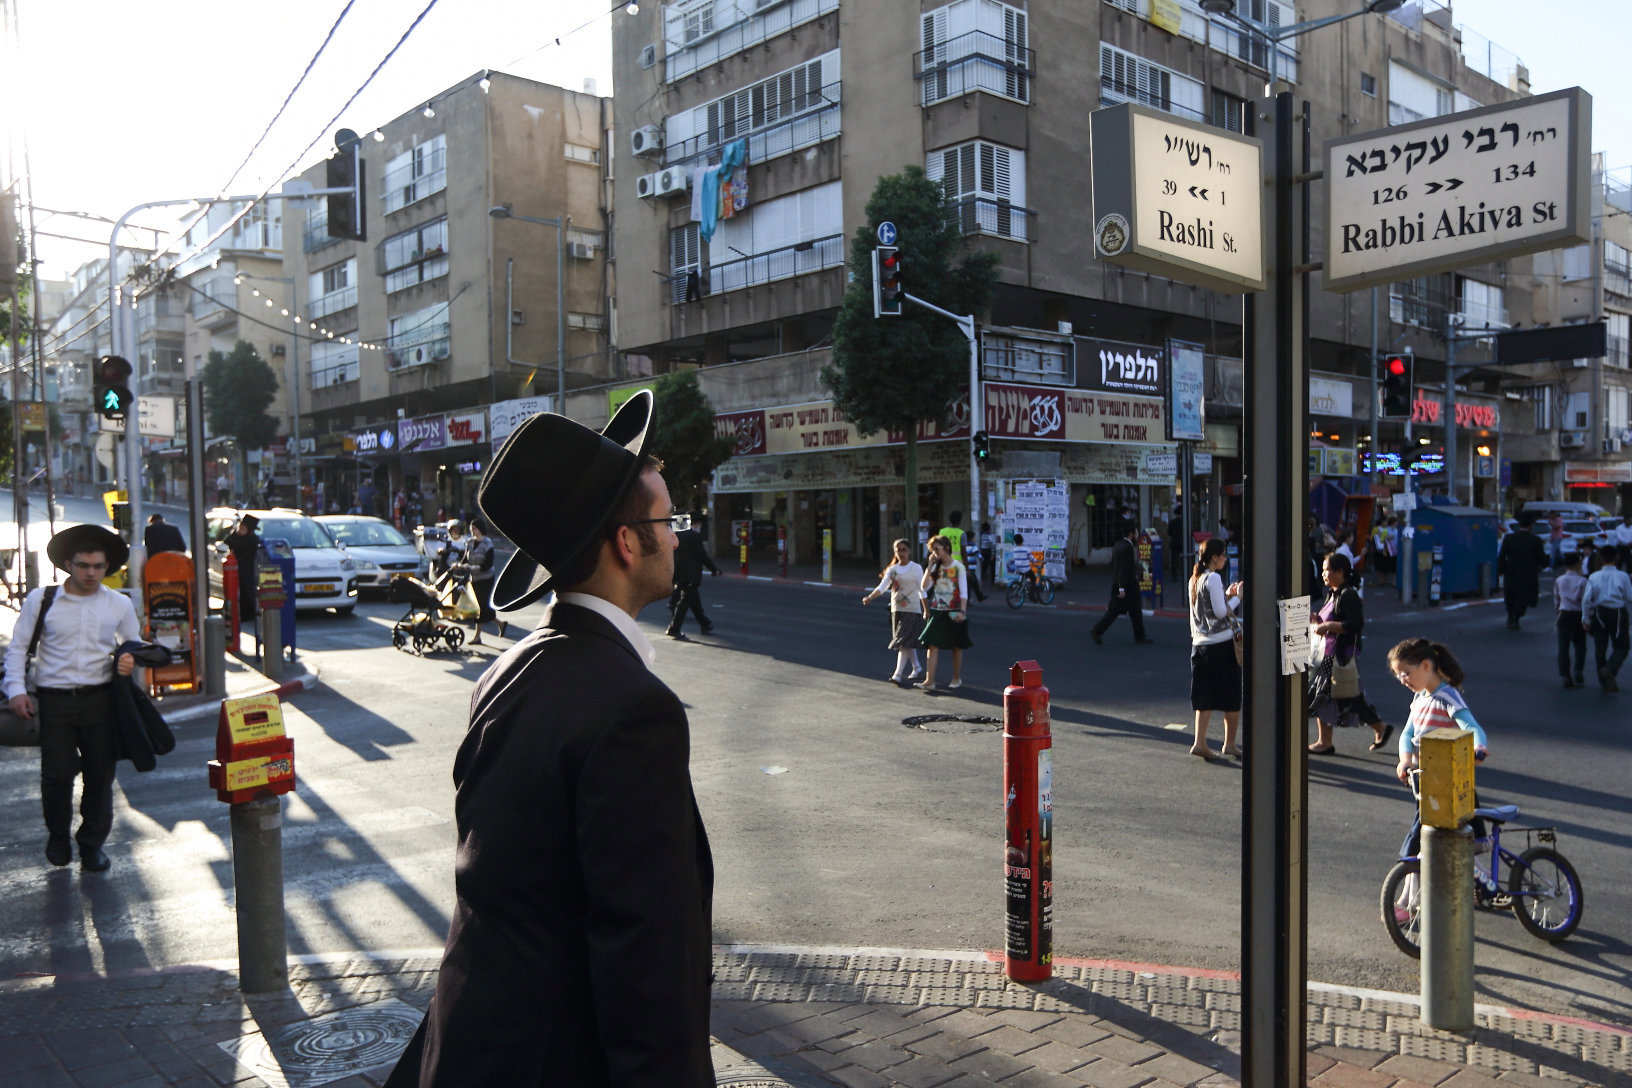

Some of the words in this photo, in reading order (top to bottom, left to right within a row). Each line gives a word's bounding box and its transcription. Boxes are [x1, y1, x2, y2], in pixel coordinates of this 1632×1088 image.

[1462, 120, 1519, 153] רבי
[1526, 126, 1557, 146] רח'
[1345, 133, 1450, 178] עקיבא
[1162, 179, 1178, 197] 39
[1220, 190, 1227, 207] 1
[1372, 185, 1408, 206] 126
[1492, 160, 1537, 184] 134
[1158, 208, 1215, 249] Rashi
[1222, 231, 1238, 254] St.
[1342, 210, 1425, 255] Rabbi
[1432, 201, 1523, 240] Akiva
[1532, 199, 1557, 224] St
[1098, 348, 1159, 385] הלפרין
[769, 412, 794, 430] קדושה
[1067, 396, 1094, 416] קדושה
